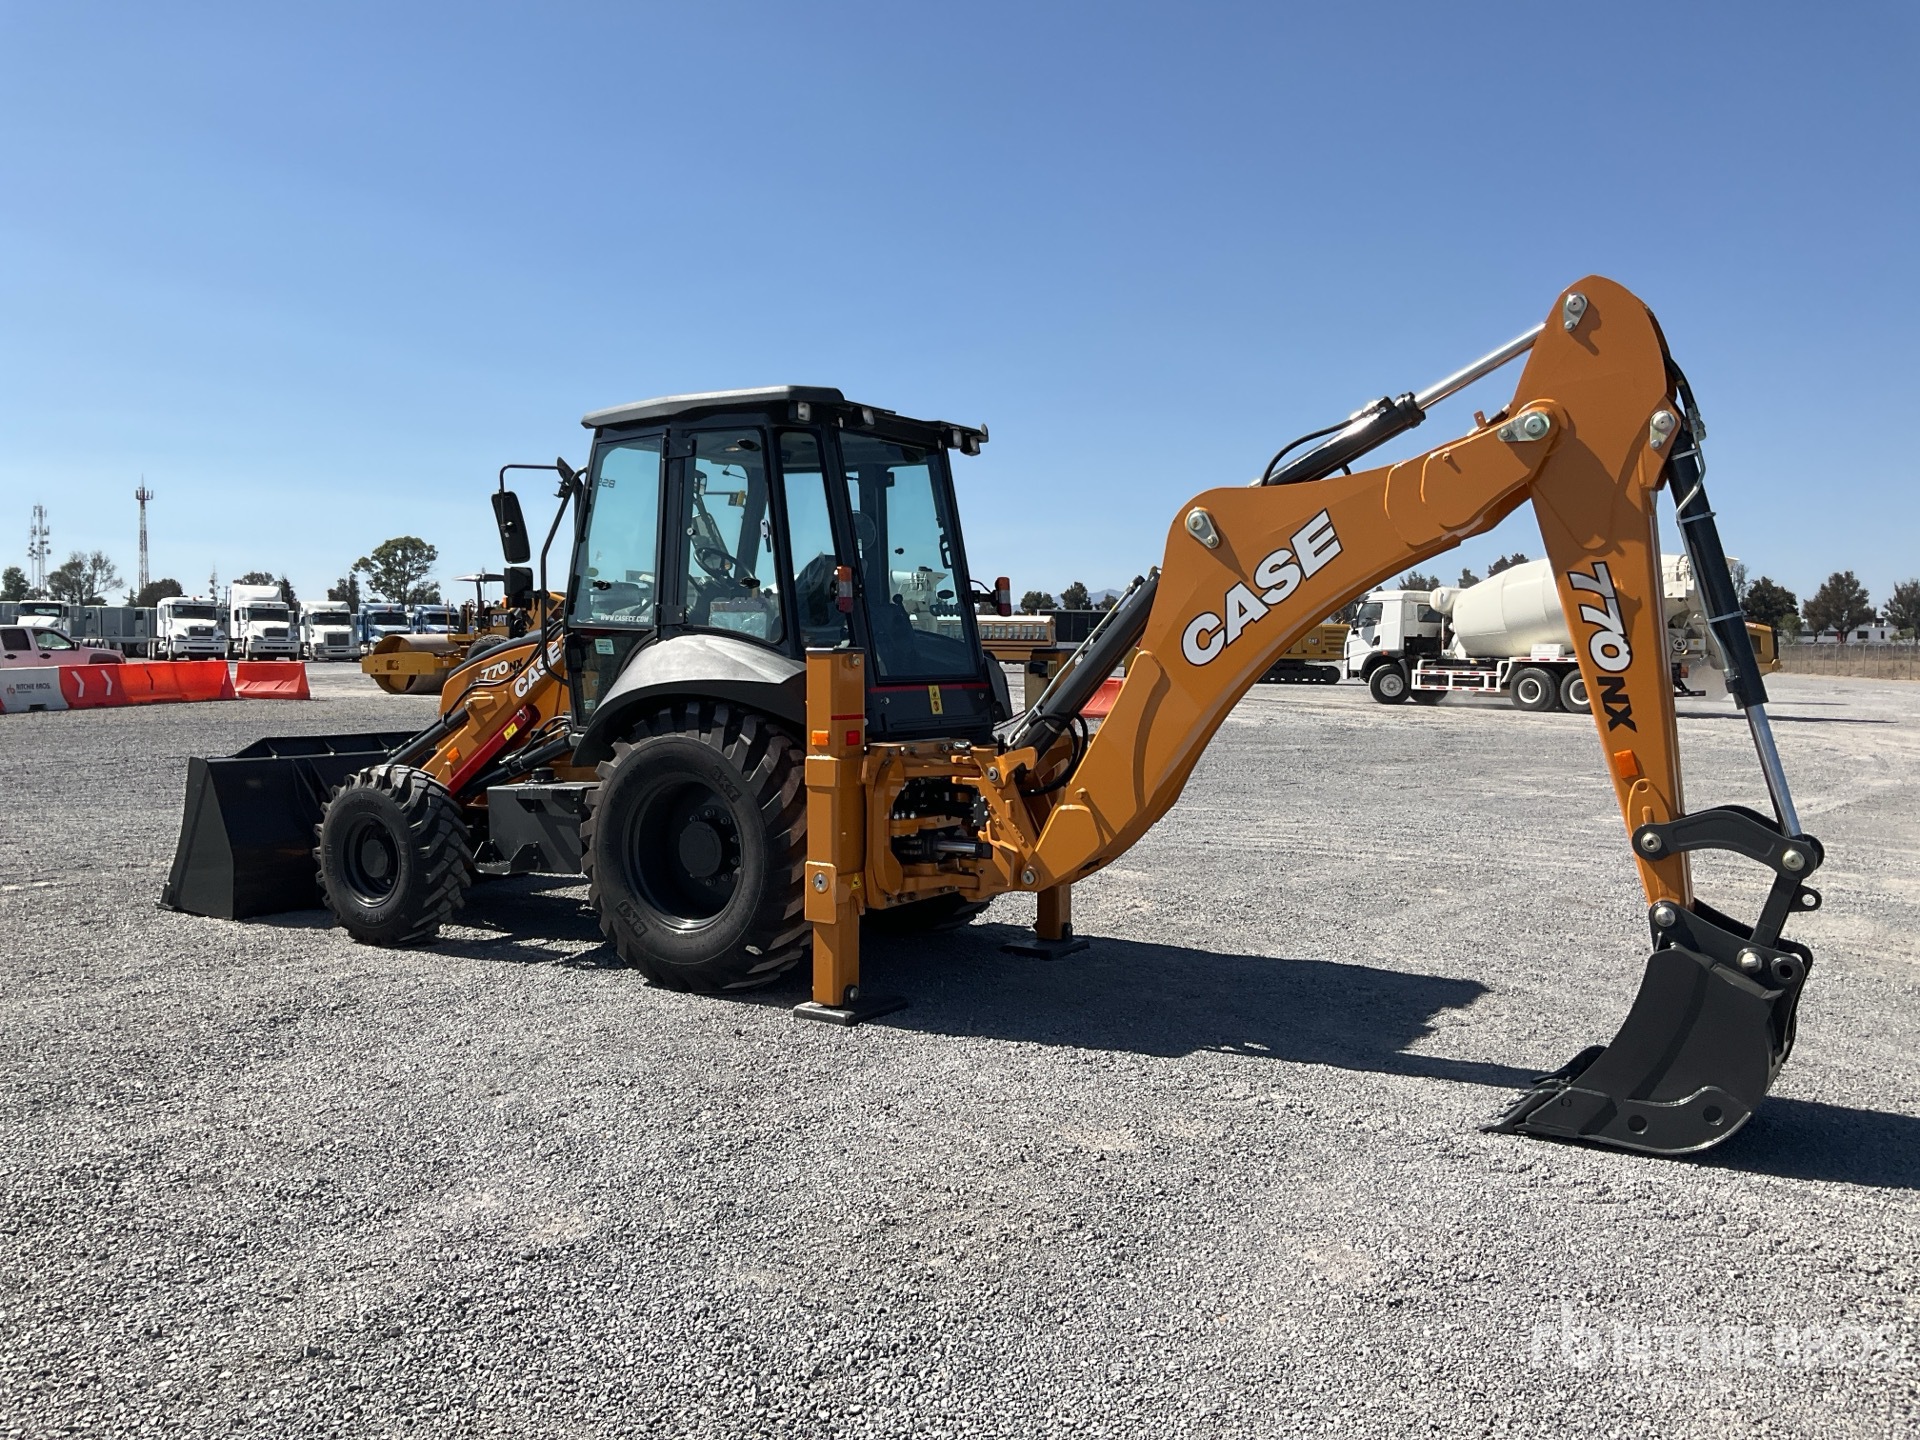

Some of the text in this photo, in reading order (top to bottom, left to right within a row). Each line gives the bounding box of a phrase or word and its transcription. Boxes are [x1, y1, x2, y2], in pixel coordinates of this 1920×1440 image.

[1181, 507, 1344, 667] CASE
[492, 614, 508, 627] CAT
[600, 614, 649, 623] WWW.CASECE.COM
[514, 641, 562, 698] CASE
[713, 766, 742, 802] BKT
[617, 901, 647, 937] BKT
